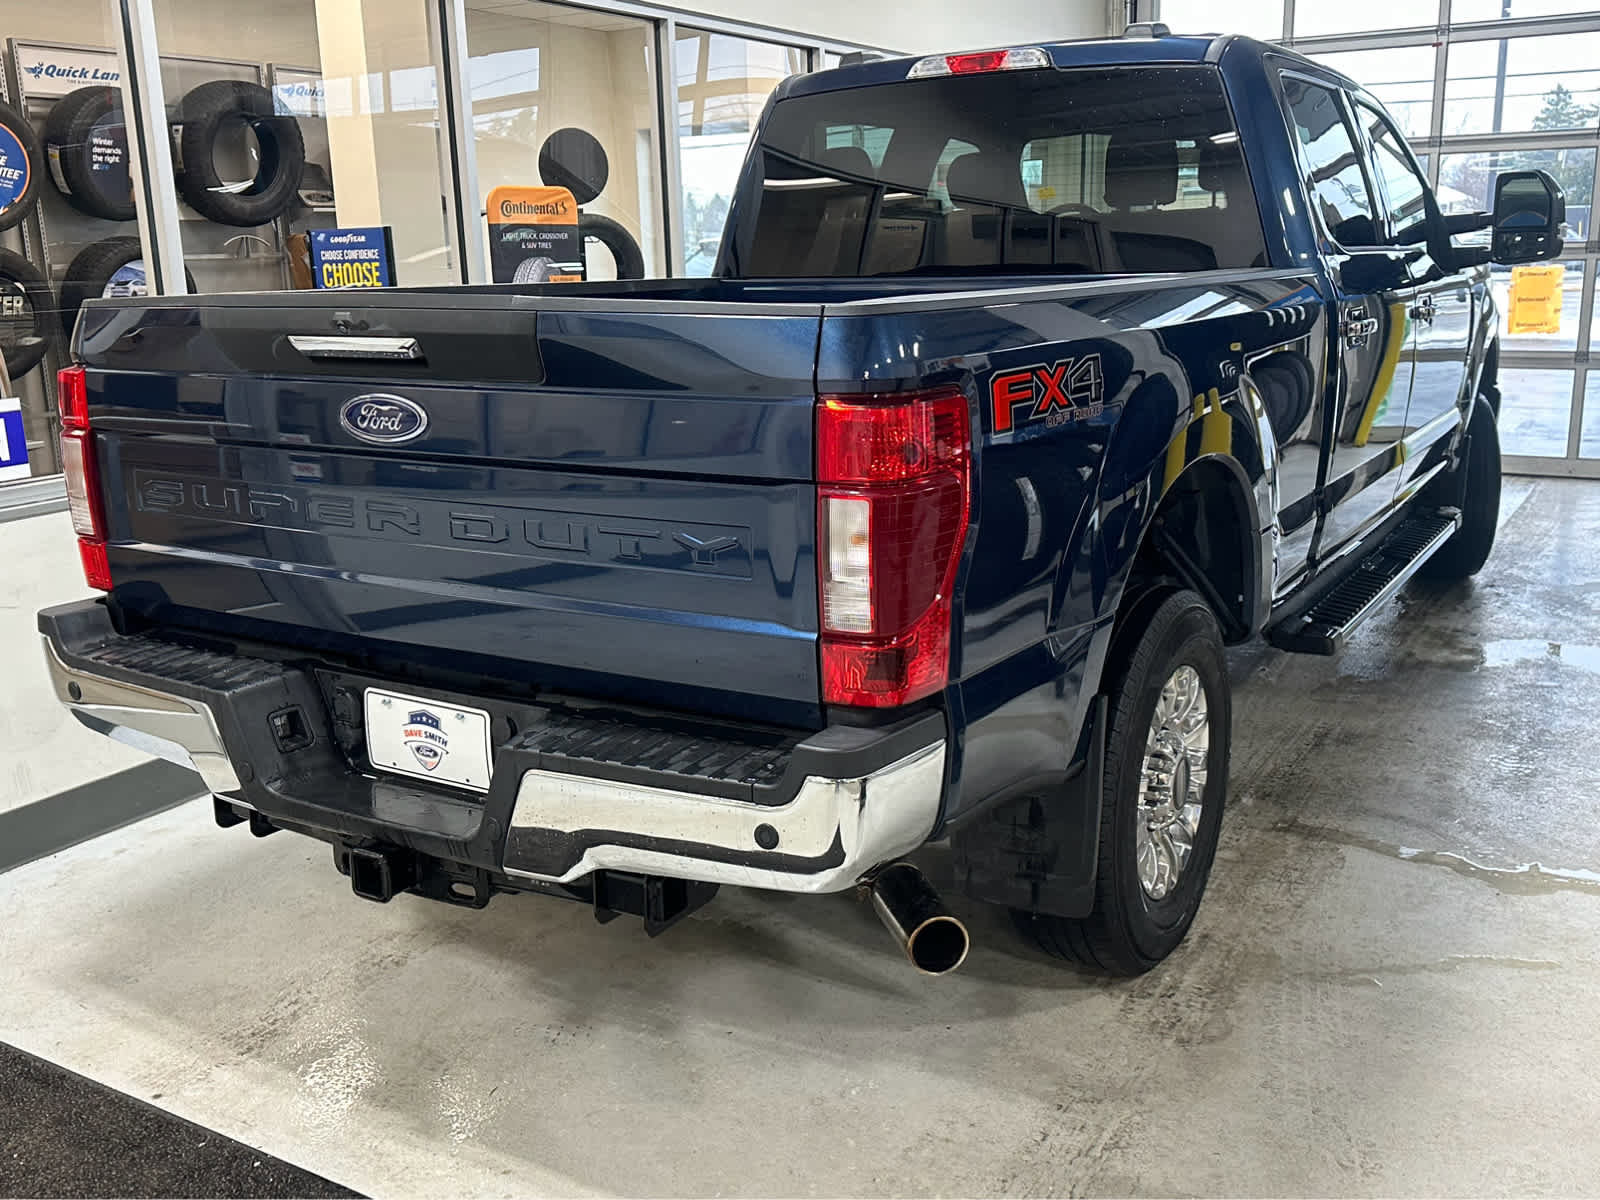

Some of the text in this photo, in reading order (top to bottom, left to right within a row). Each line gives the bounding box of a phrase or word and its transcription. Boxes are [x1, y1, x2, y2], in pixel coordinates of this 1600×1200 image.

[44, 64, 89, 78] Quick
[92, 154, 104, 162] the
[500, 199, 559, 217] Continental
[329, 233, 366, 244] GOODYEAR
[502, 232, 519, 241] LIGHT
[538, 232, 569, 241] CROSSOVER
[526, 241, 537, 249] SUV
[538, 241, 553, 249] TIRES
[320, 249, 379, 261] CHOOSE CONFIDENCE
[322, 262, 383, 288] CHOOSE
[0, 295, 24, 316] ER
[989, 353, 1104, 438] FX4
[357, 402, 402, 431] Ford
[137, 479, 740, 566] SUPER DUTY
[403, 729, 448, 747] DAVE SMITH
